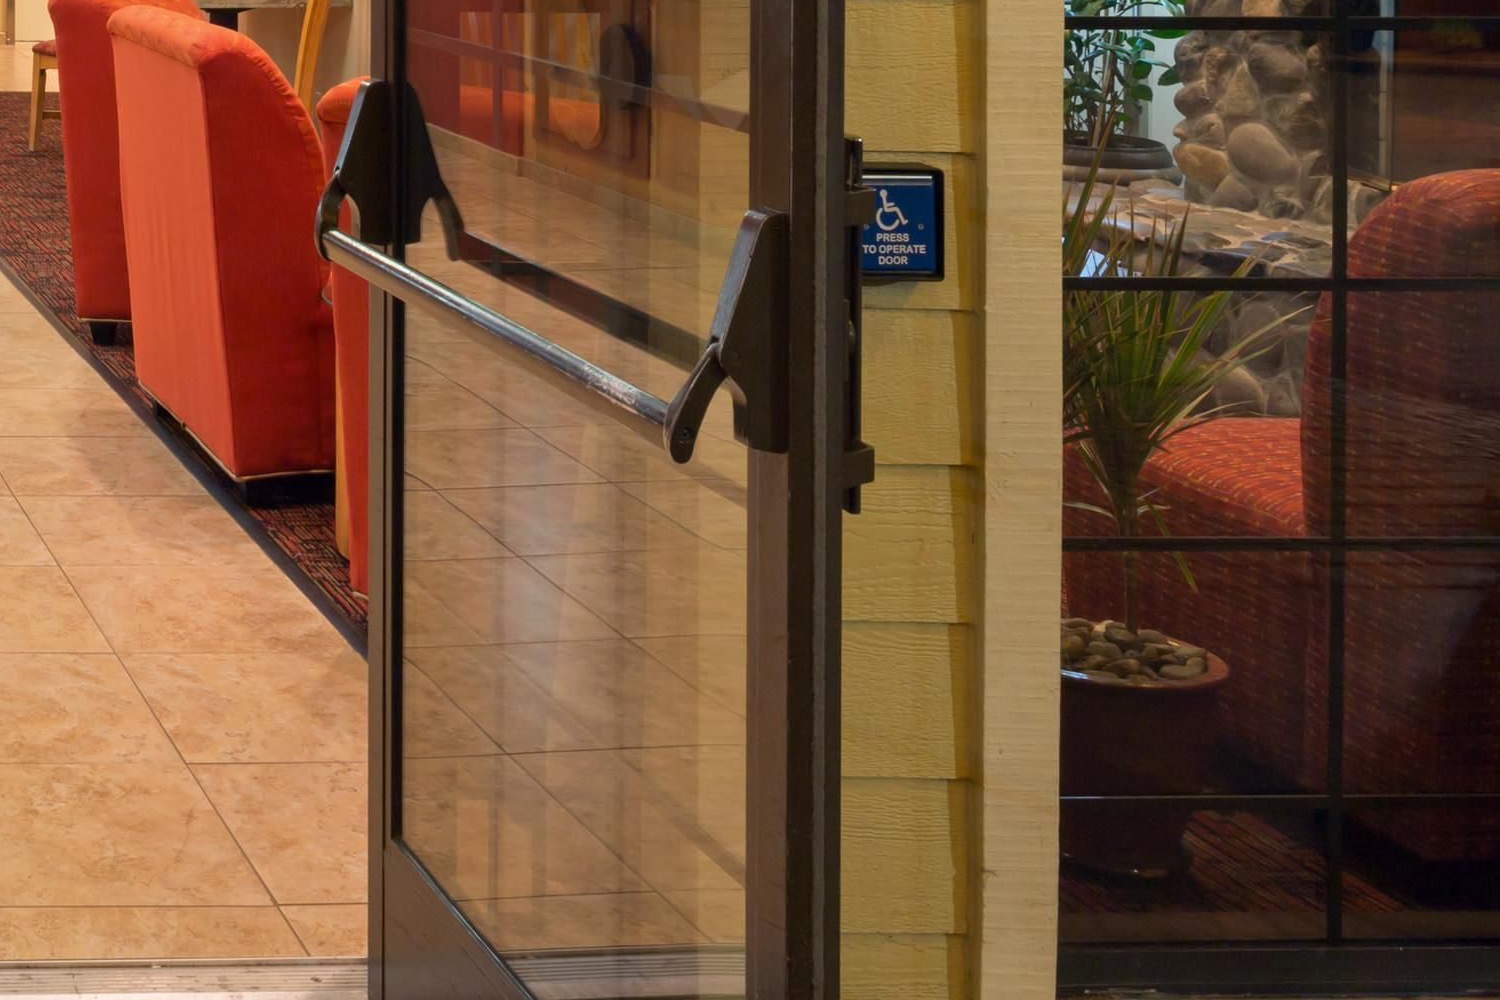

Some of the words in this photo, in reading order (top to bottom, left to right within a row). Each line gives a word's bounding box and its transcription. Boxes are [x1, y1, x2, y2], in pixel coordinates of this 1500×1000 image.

[876, 233, 909, 242] PRESS
[862, 244, 877, 254] TO
[878, 244, 927, 254] OPERATE
[878, 256, 908, 265] DOOR
